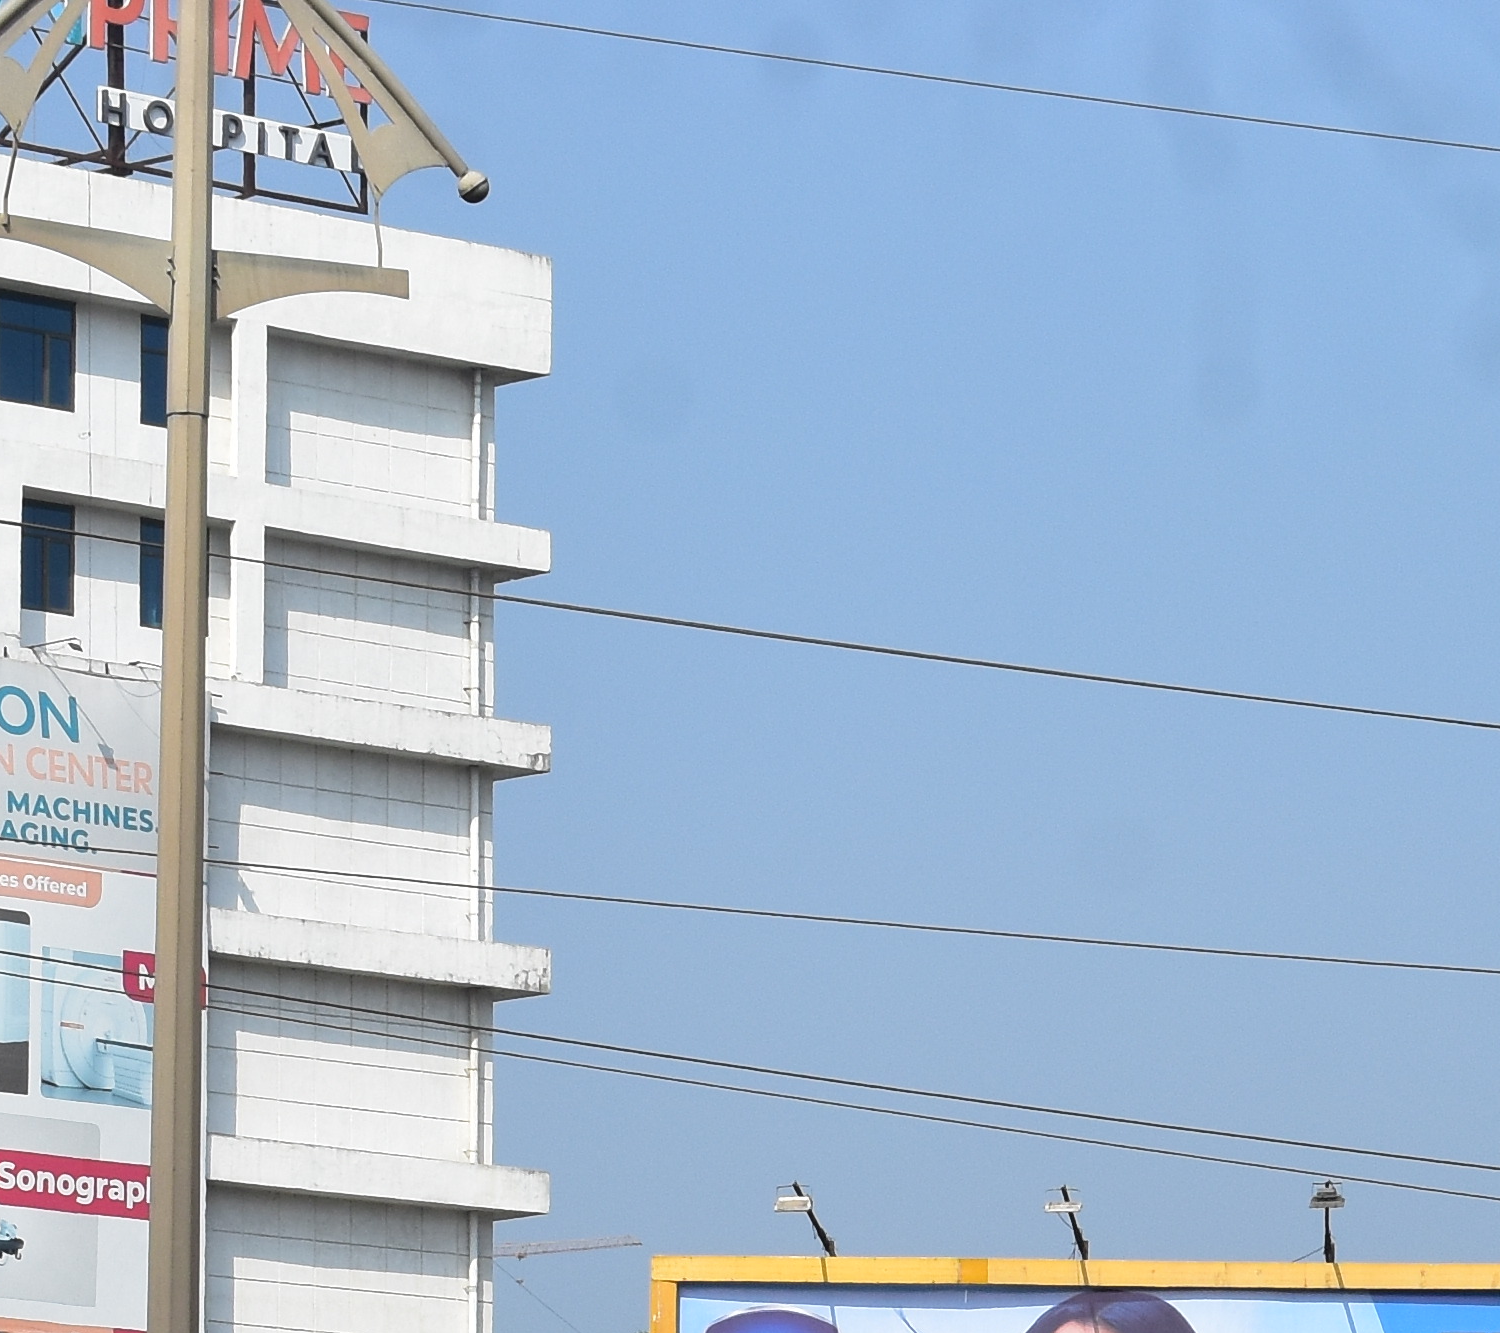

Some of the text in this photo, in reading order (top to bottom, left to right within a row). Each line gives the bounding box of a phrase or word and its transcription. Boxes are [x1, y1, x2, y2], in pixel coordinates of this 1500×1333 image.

[101, 89, 366, 173] HOPITAL
[26, 746, 154, 796] CENTER
[23, 874, 88, 899] Offered
